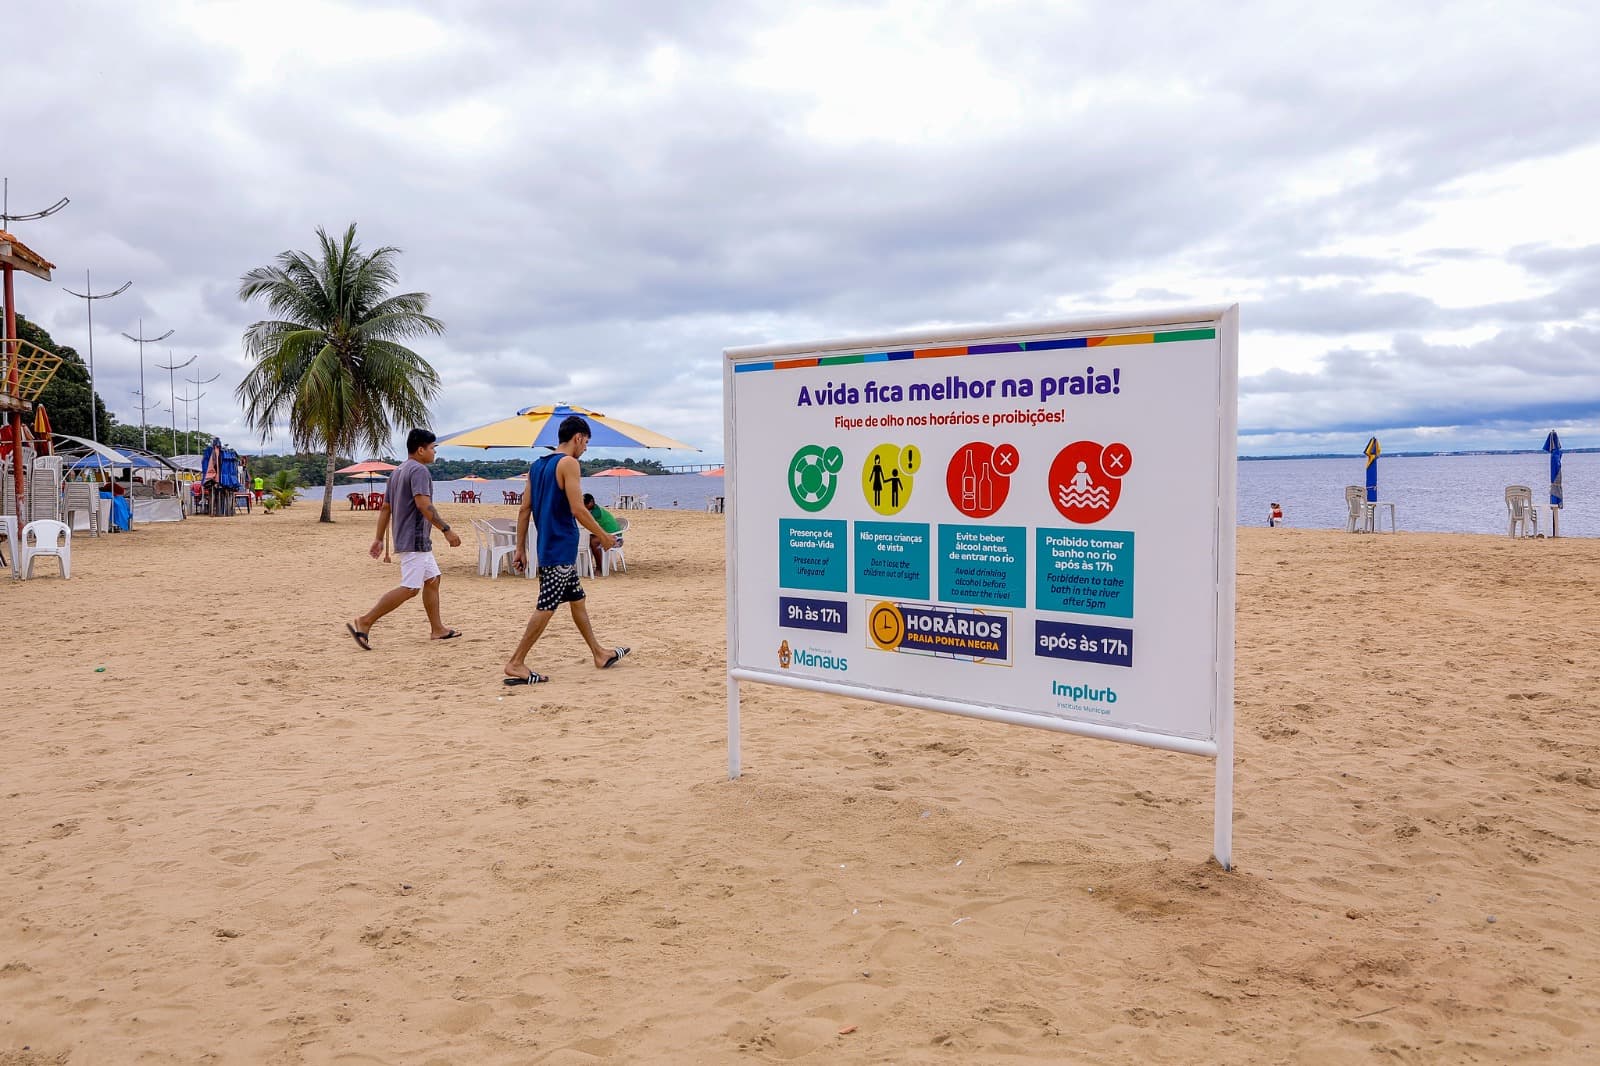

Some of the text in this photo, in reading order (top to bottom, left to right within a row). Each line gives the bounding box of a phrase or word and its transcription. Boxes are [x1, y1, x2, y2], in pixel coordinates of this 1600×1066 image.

[797, 366, 1120, 406] A vida fica melhor na praia!
[835, 408, 1065, 430] Fique de olho nos horários e proibições!
[790, 528, 833, 539] Presença de
[860, 531, 923, 544] Não perca crianças
[956, 532, 1005, 543] Evite beber
[790, 539, 835, 549] Guarda-Vida
[877, 543, 904, 552] de vista
[955, 541, 1007, 553] álcool antes
[1046, 536, 1125, 550] Proibido tomar
[949, 552, 960, 560] de
[961, 554, 988, 562] entrar
[1002, 554, 1015, 563] rio
[1052, 547, 1117, 560] banho no rio
[793, 556, 821, 565] Presence
[1055, 559, 1113, 572] após às 17h
[1047, 573, 1125, 587] Forbidden to take
[951, 588, 959, 596] to
[980, 589, 993, 598] the
[1050, 584, 1120, 598] bath in the river
[1062, 597, 1107, 610] after 5pm
[788, 605, 841, 624] 9h às 17h
[907, 614, 1002, 639] HORÁRIOS
[907, 633, 1000, 651] PRAIA PONTA NEGRA
[1039, 632, 1128, 656] após às 17h
[794, 648, 848, 671] Manaus
[1052, 680, 1117, 703] Implurb
[1057, 702, 1082, 711] Instituto
